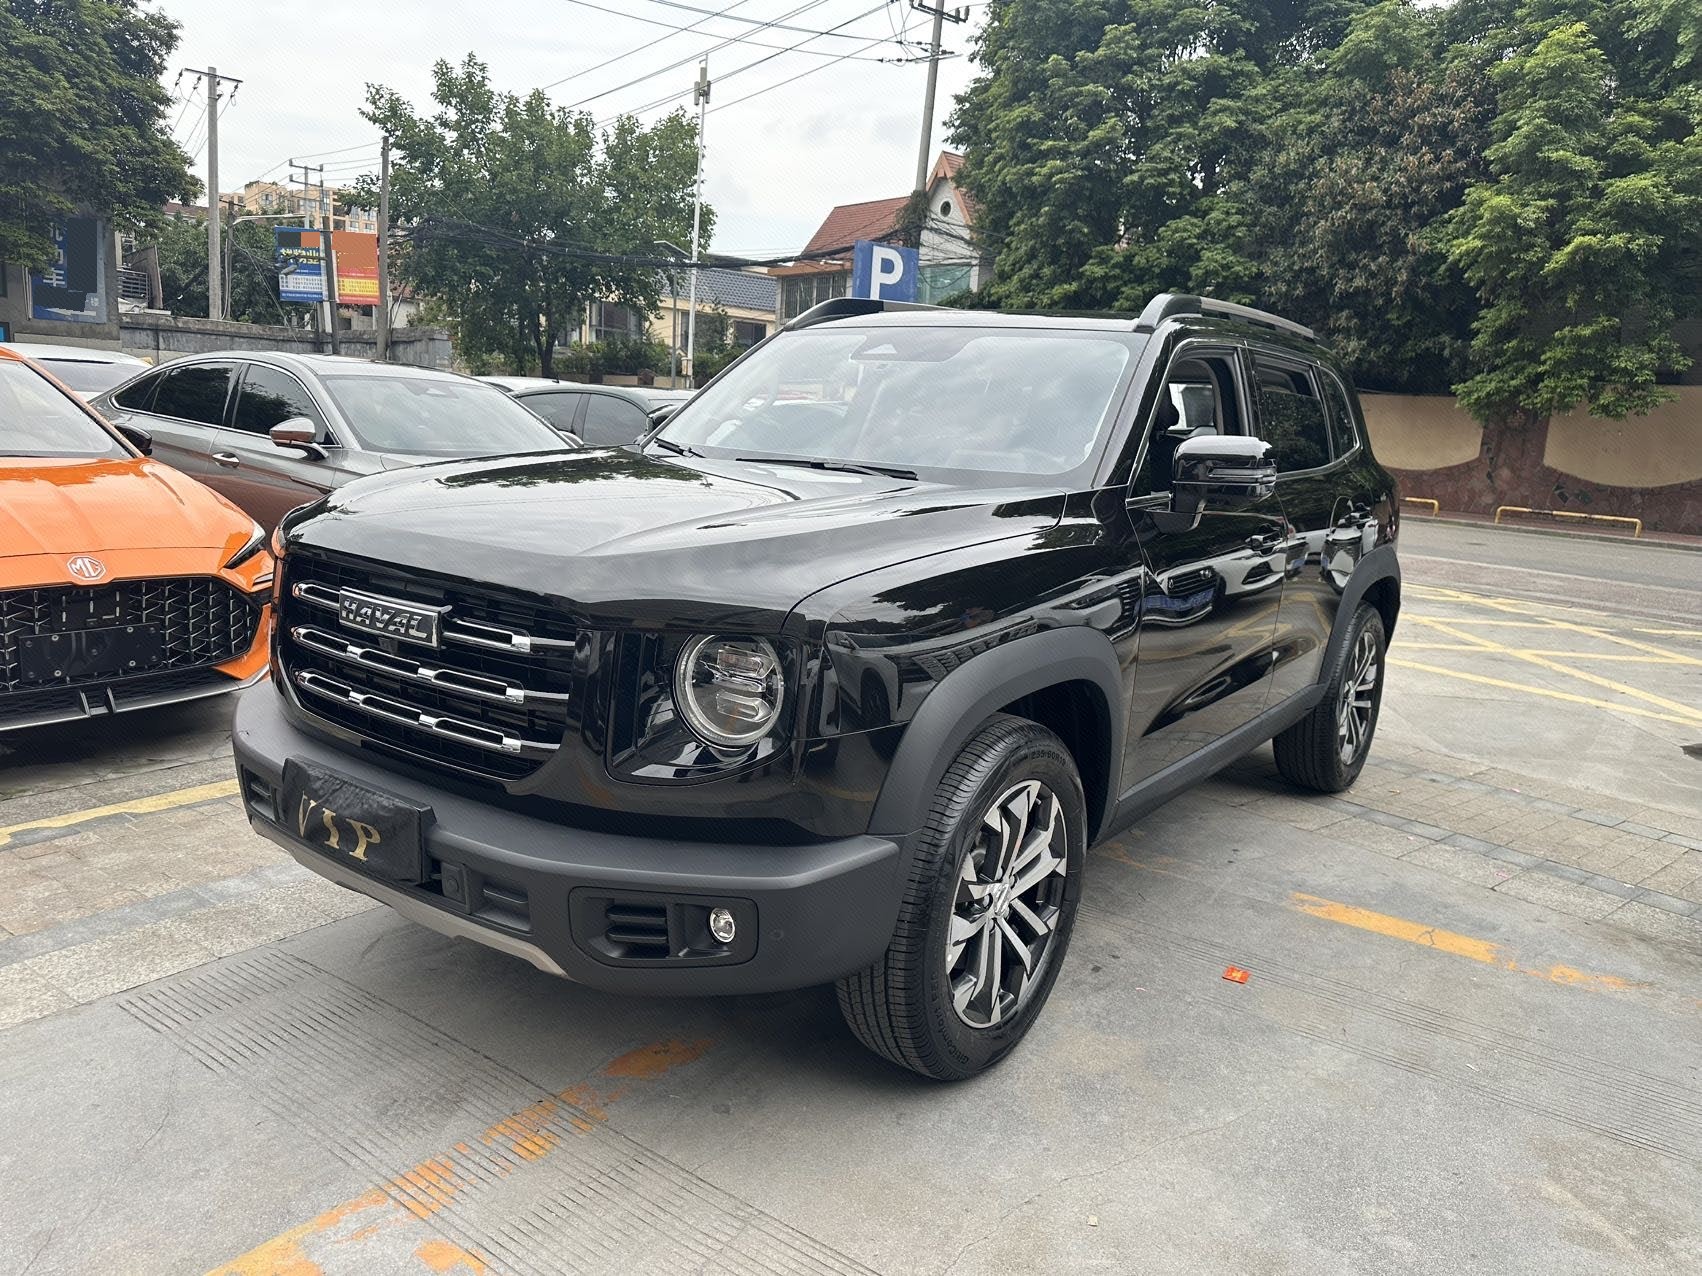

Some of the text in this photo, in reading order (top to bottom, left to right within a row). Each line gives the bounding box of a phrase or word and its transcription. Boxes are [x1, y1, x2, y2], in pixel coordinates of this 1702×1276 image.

[871, 246, 904, 300] P
[69, 558, 104, 579] MG
[341, 599, 427, 638] HAVAL
[298, 790, 381, 863] VIP
